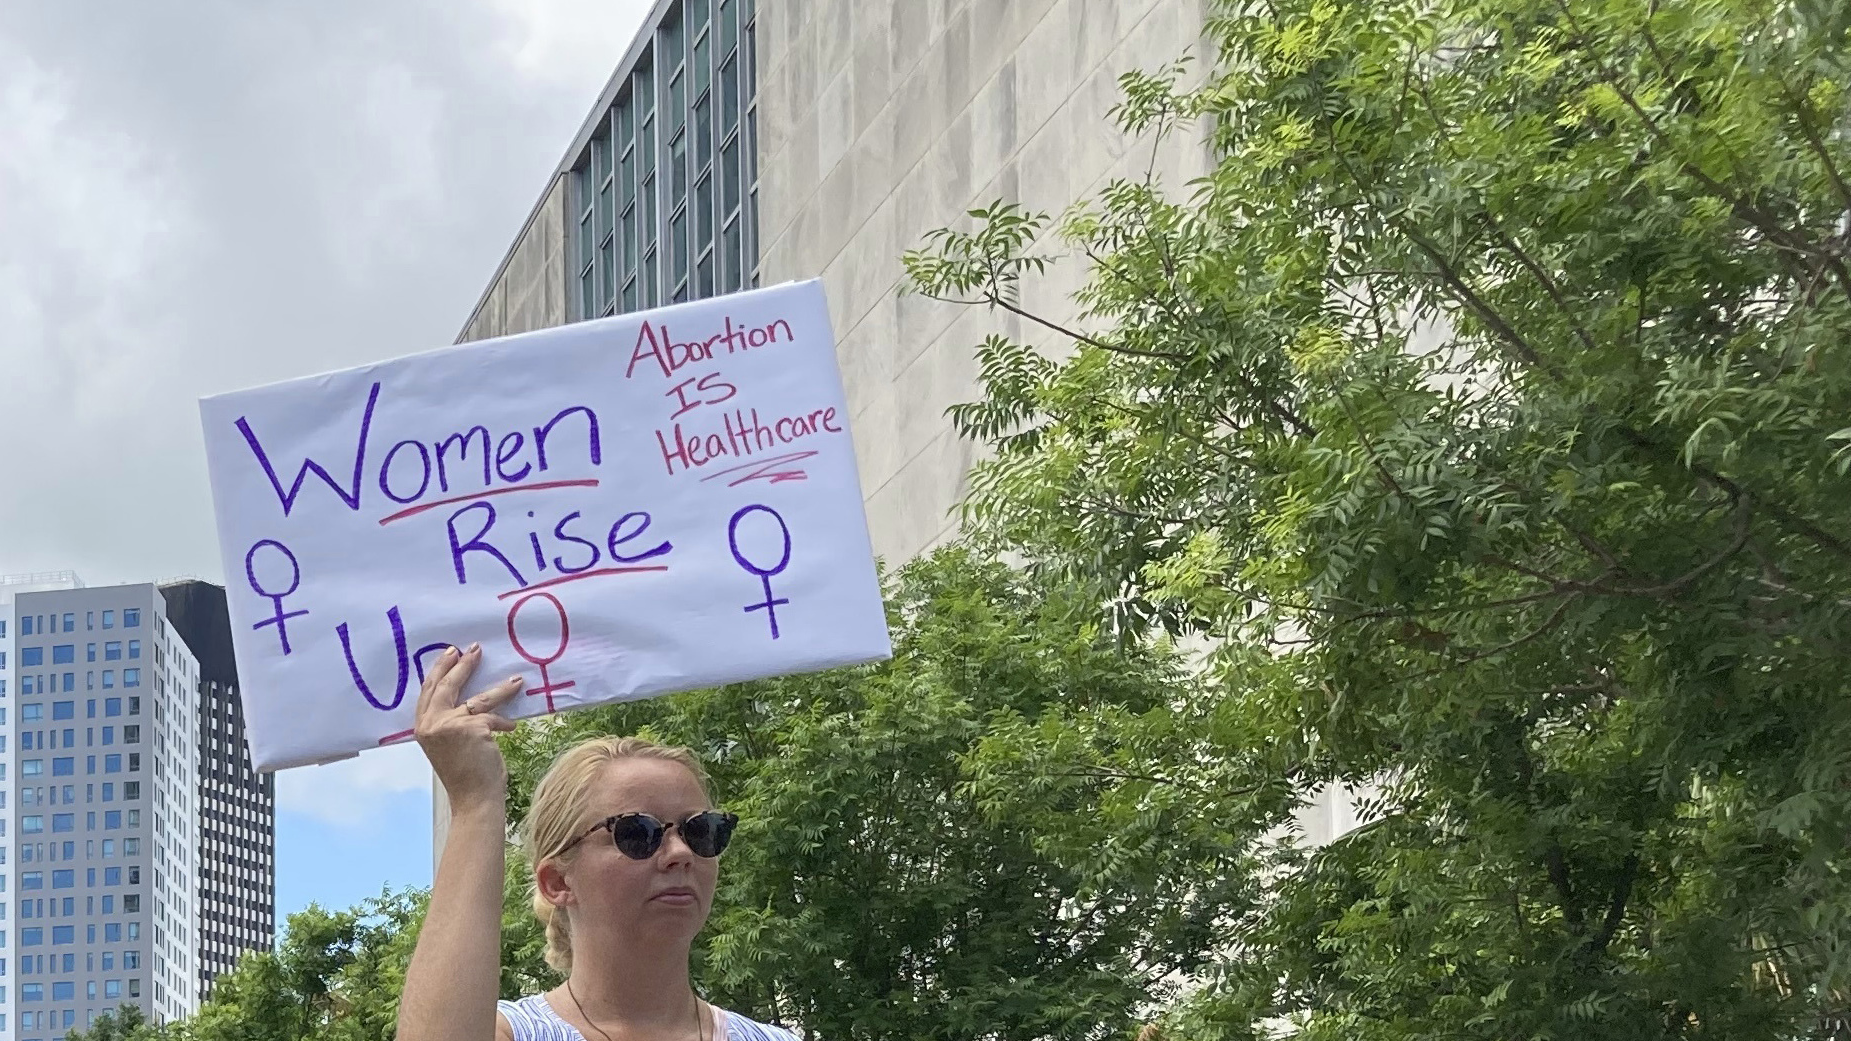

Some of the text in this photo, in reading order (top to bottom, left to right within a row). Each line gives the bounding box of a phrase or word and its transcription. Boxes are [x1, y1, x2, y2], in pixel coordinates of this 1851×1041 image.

[626, 317, 794, 379] Abortion
[234, 381, 602, 517] Women
[655, 406, 844, 476] Healthcare
[447, 501, 673, 587] Rise
